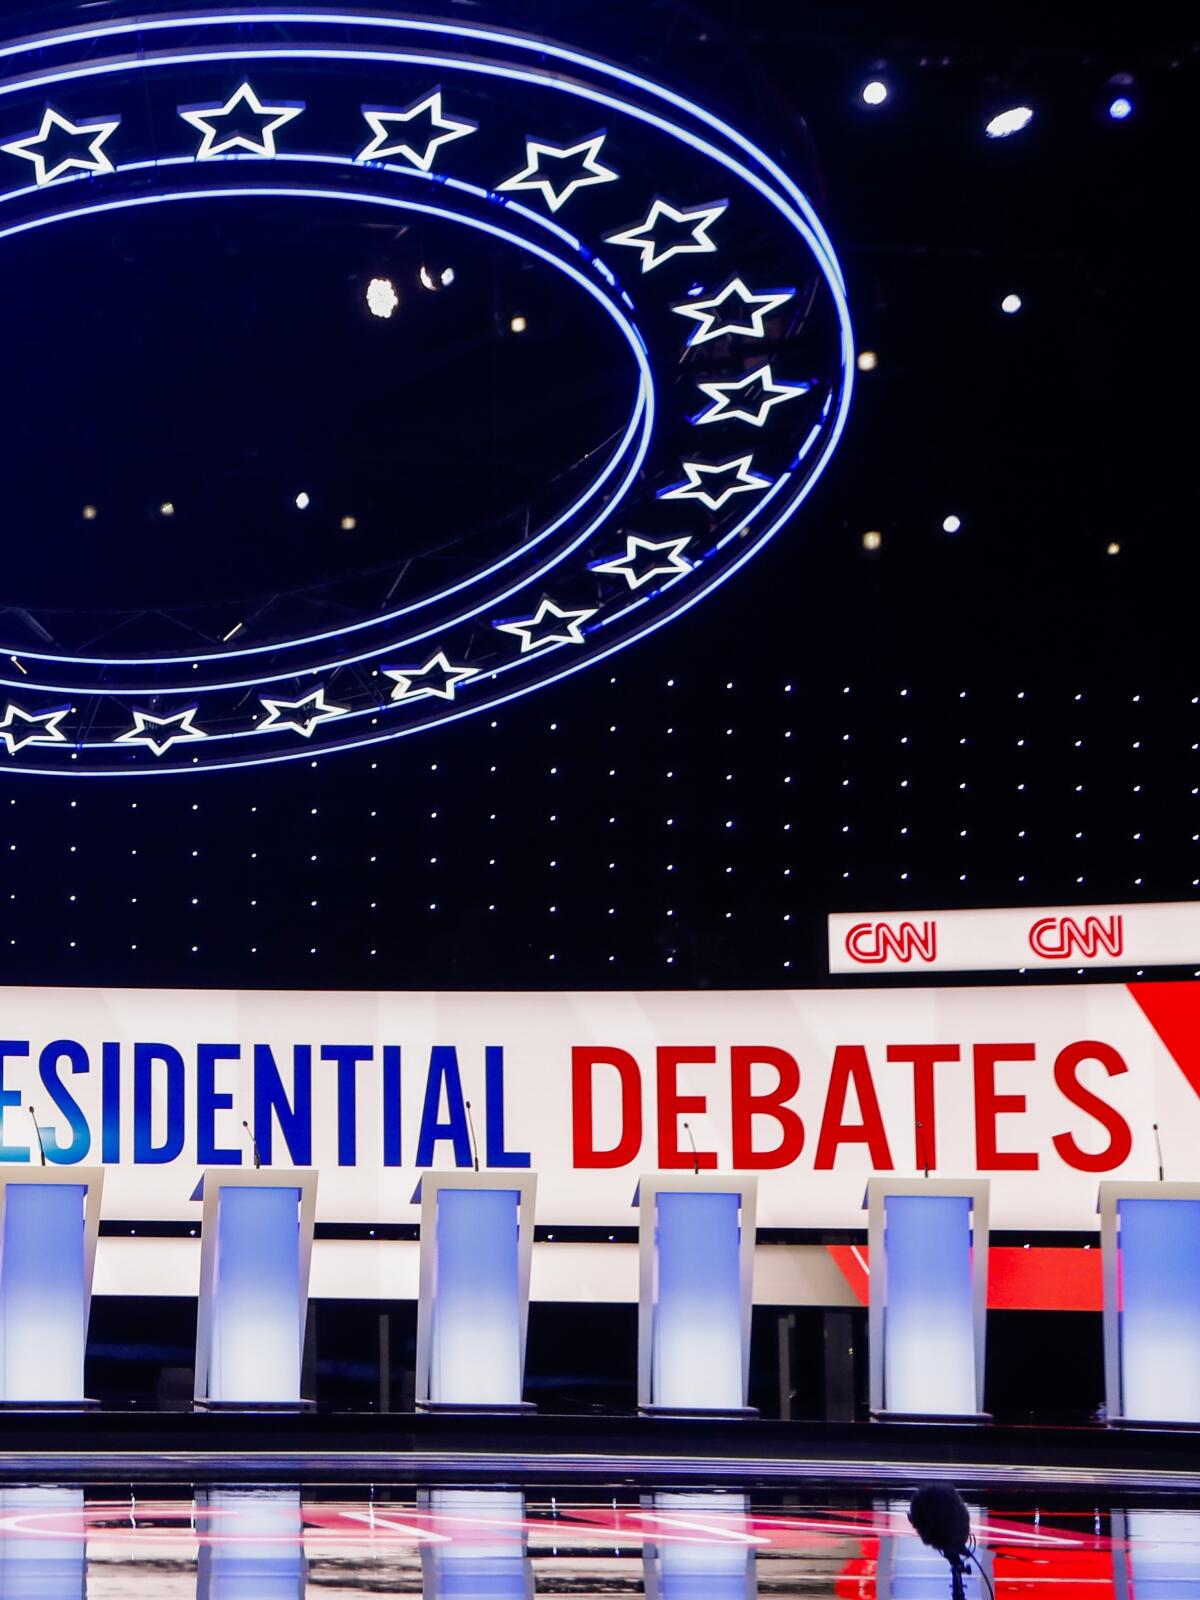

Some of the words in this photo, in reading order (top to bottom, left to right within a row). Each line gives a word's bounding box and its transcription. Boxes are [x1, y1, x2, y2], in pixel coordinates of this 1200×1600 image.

[845, 921, 936, 964] CNN
[1029, 915, 1123, 959] CNN
[571, 1040, 1133, 1173] DEBATES
